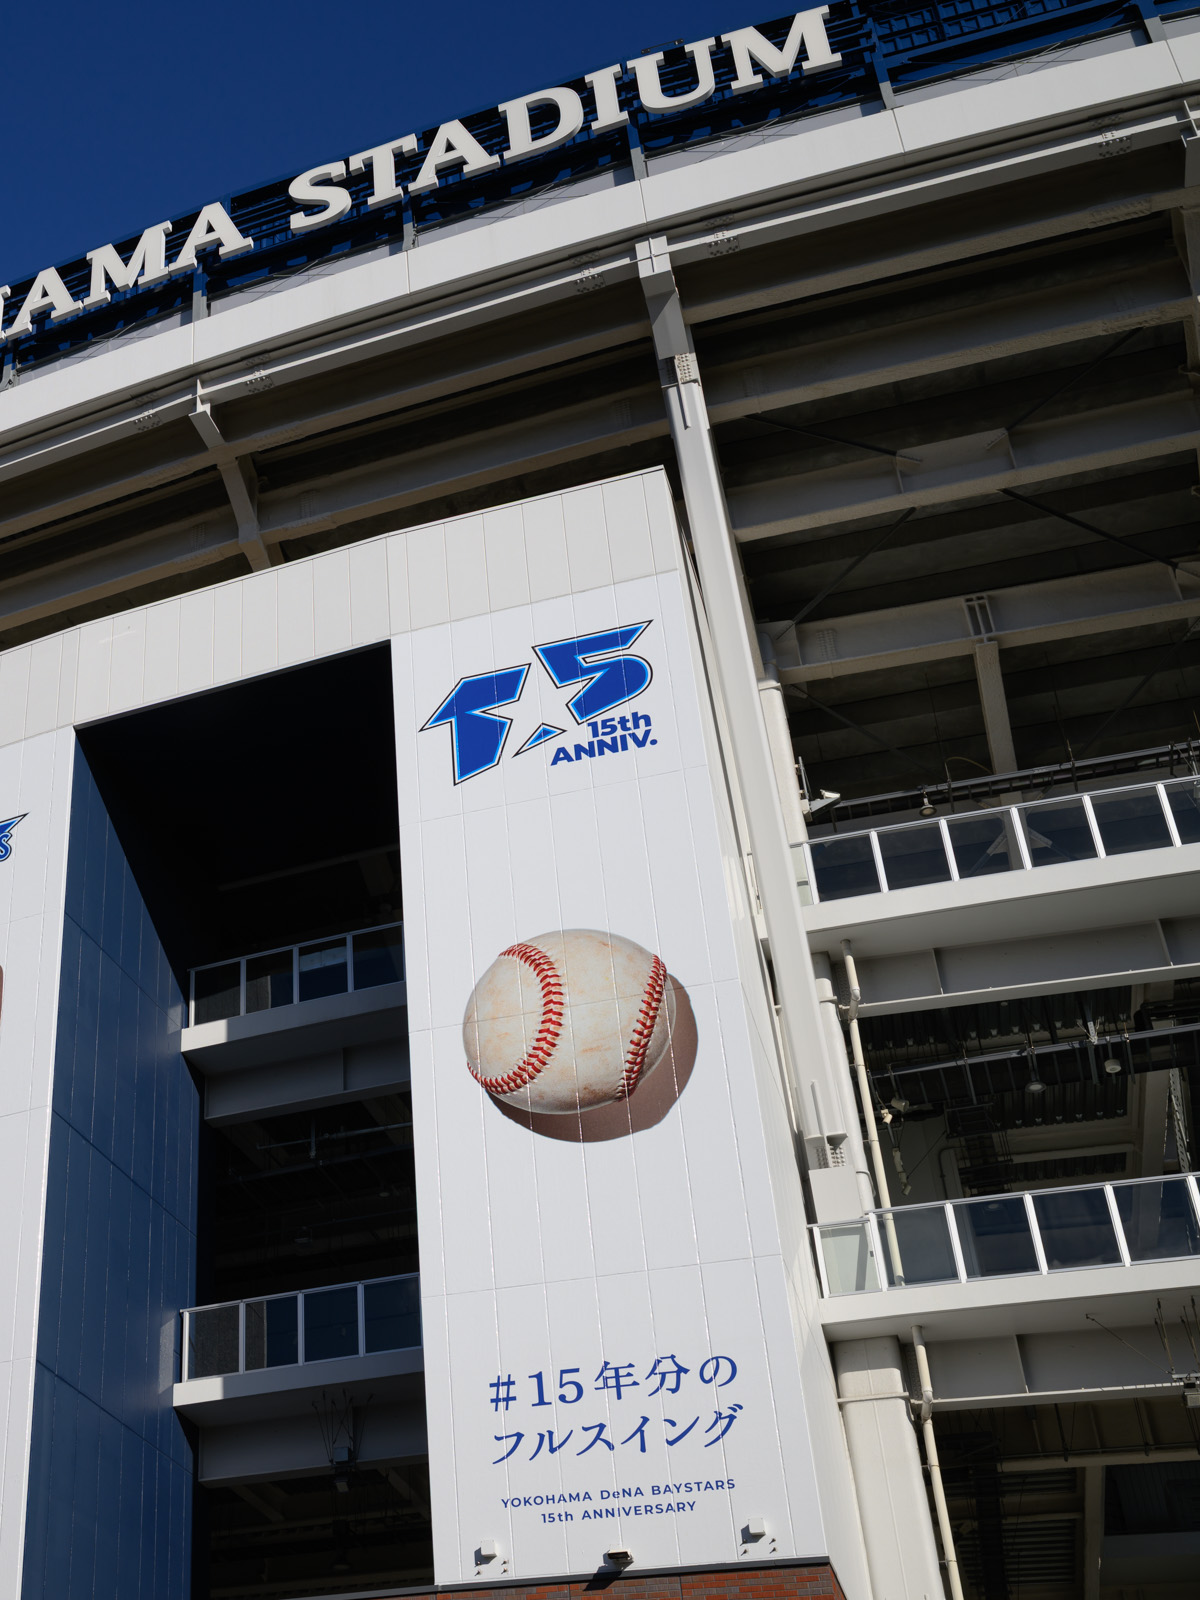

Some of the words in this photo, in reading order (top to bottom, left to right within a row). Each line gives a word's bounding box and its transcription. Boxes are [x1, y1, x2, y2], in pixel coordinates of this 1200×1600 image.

[288, 4, 843, 234] STADIUM
[587, 711, 652, 739] 15th
[550, 729, 658, 766] ANNIV.
[489, 1354, 738, 1412] #15年分の
[492, 1403, 744, 1465] フルスイング
[501, 1491, 592, 1509] YOKOHAMA
[600, 1488, 644, 1501] DeNA
[651, 1478, 736, 1496] BAYSTARS
[541, 1511, 574, 1524] 15th
[581, 1500, 697, 1521] ANNIVERSARY
